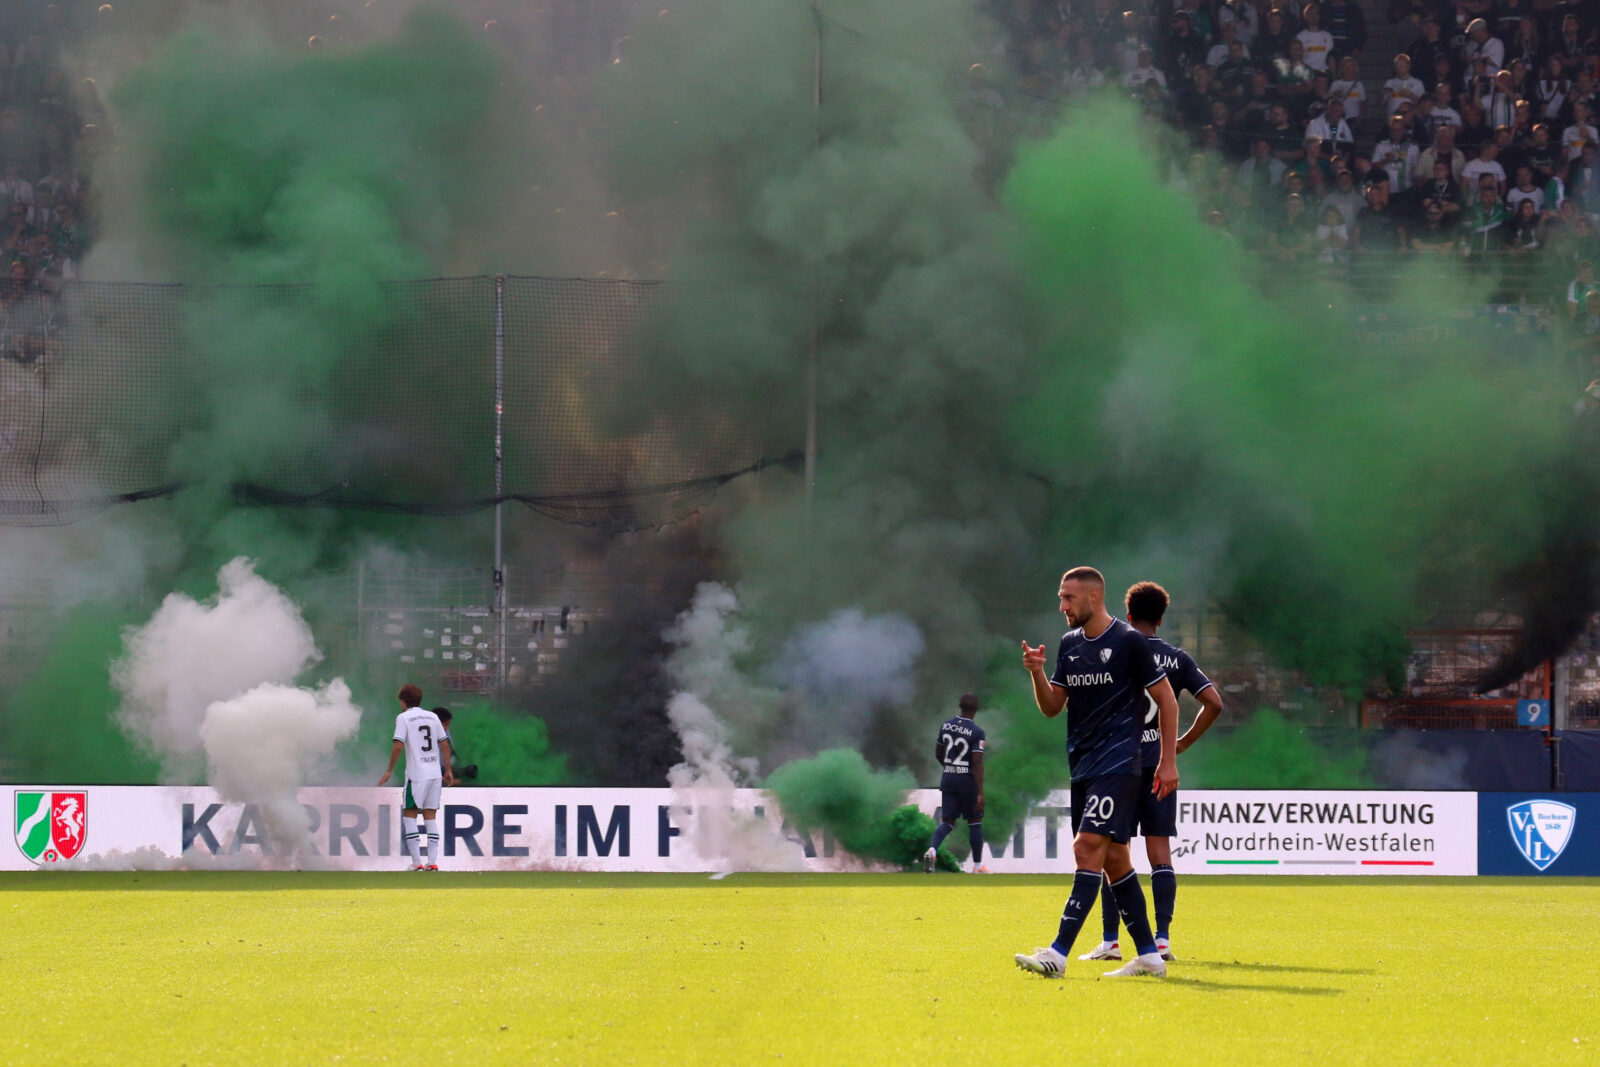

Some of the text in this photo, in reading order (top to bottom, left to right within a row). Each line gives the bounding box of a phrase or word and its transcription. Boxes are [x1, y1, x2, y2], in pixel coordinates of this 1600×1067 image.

[1066, 671, 1114, 687] VONOVIA
[1527, 703, 1541, 722] 9
[418, 725, 433, 752] 3
[942, 733, 970, 766] 22
[1085, 794, 1115, 820] 20
[1180, 802, 1434, 825] FINANZVERWALTUNG
[555, 804, 631, 857] IM
[1170, 832, 1434, 858] ür Nordrhein-Westfalen
